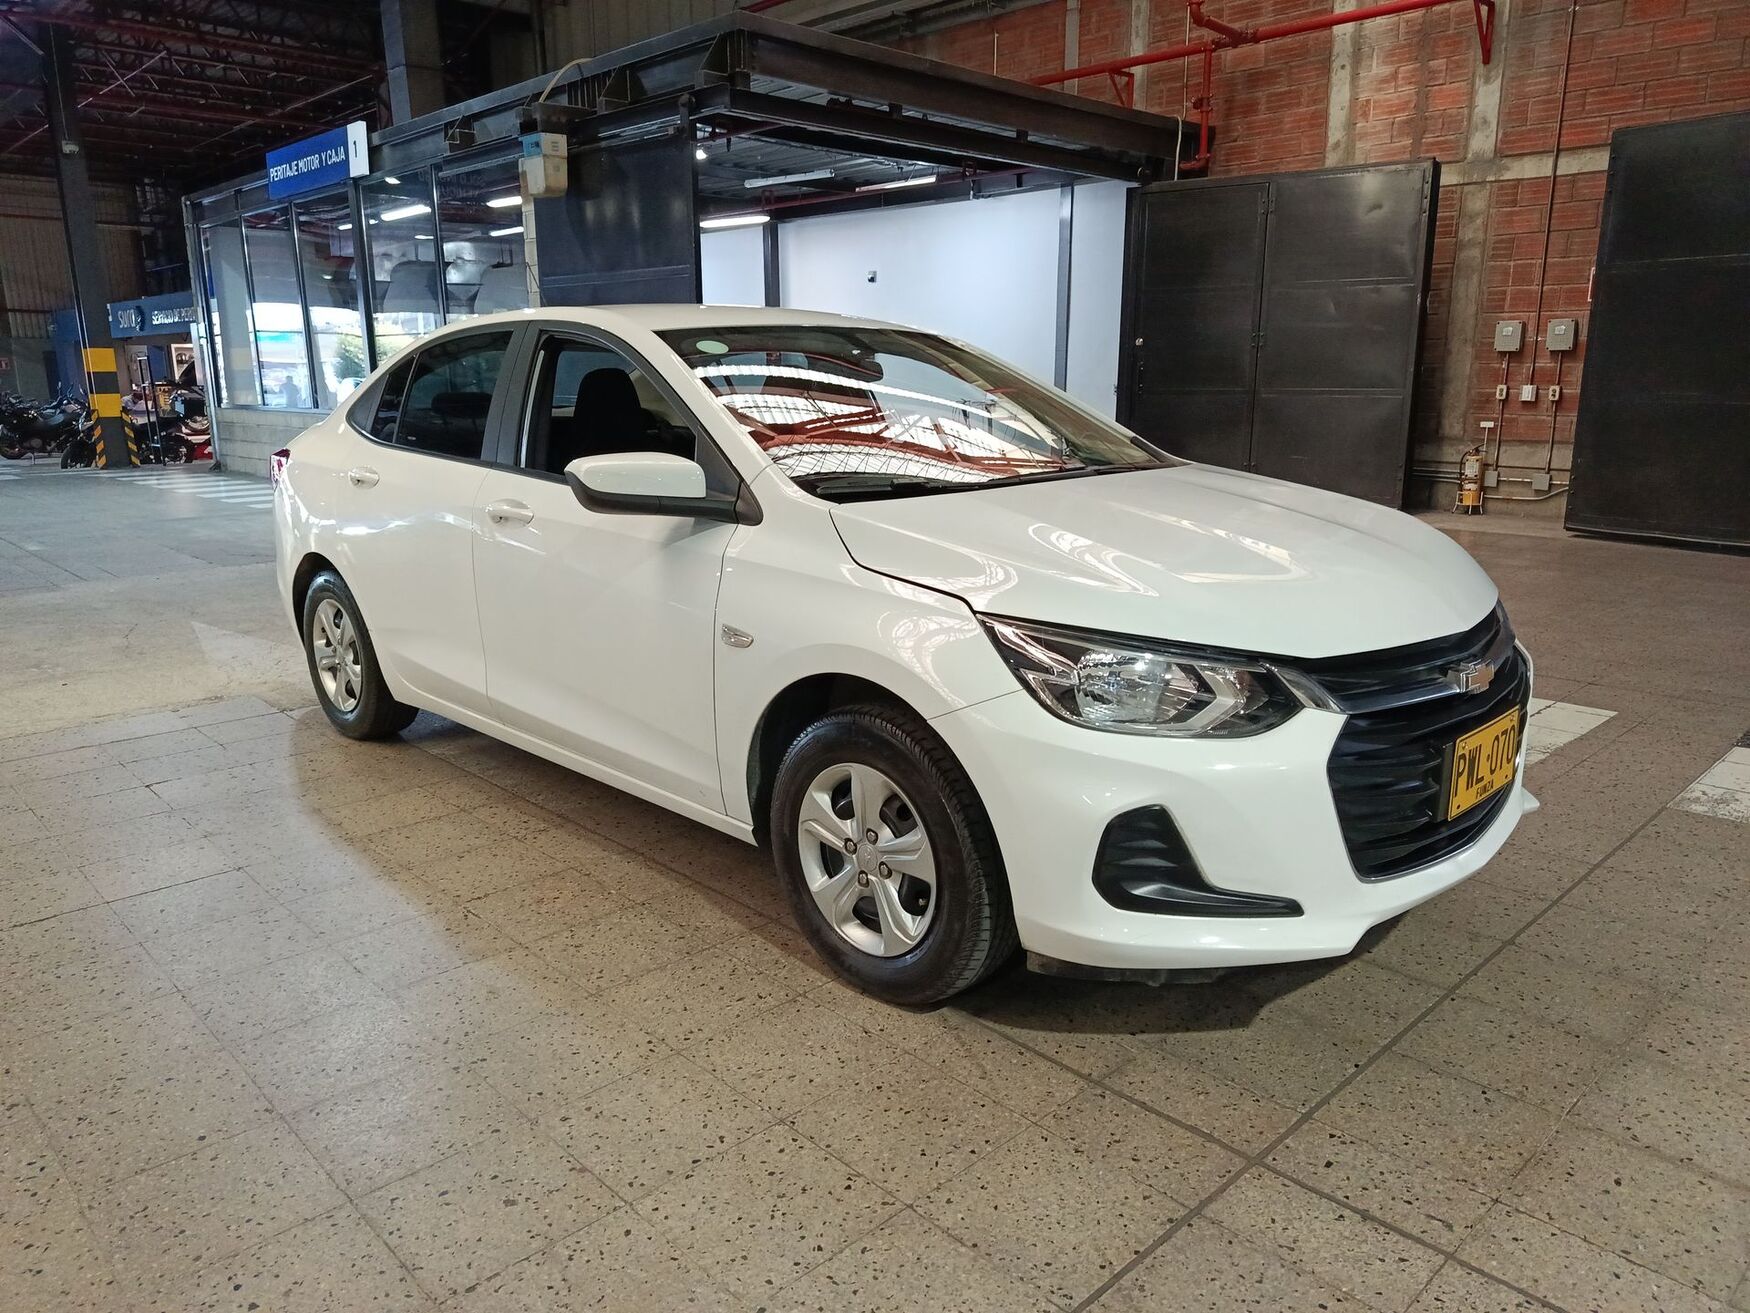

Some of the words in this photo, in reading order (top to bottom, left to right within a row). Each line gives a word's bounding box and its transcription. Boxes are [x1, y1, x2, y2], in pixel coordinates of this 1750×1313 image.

[352, 139, 358, 159] 1
[269, 161, 298, 182] PERITAJE
[298, 154, 320, 174] MOTOR
[321, 151, 326, 167] Y
[327, 145, 346, 165] CAJA
